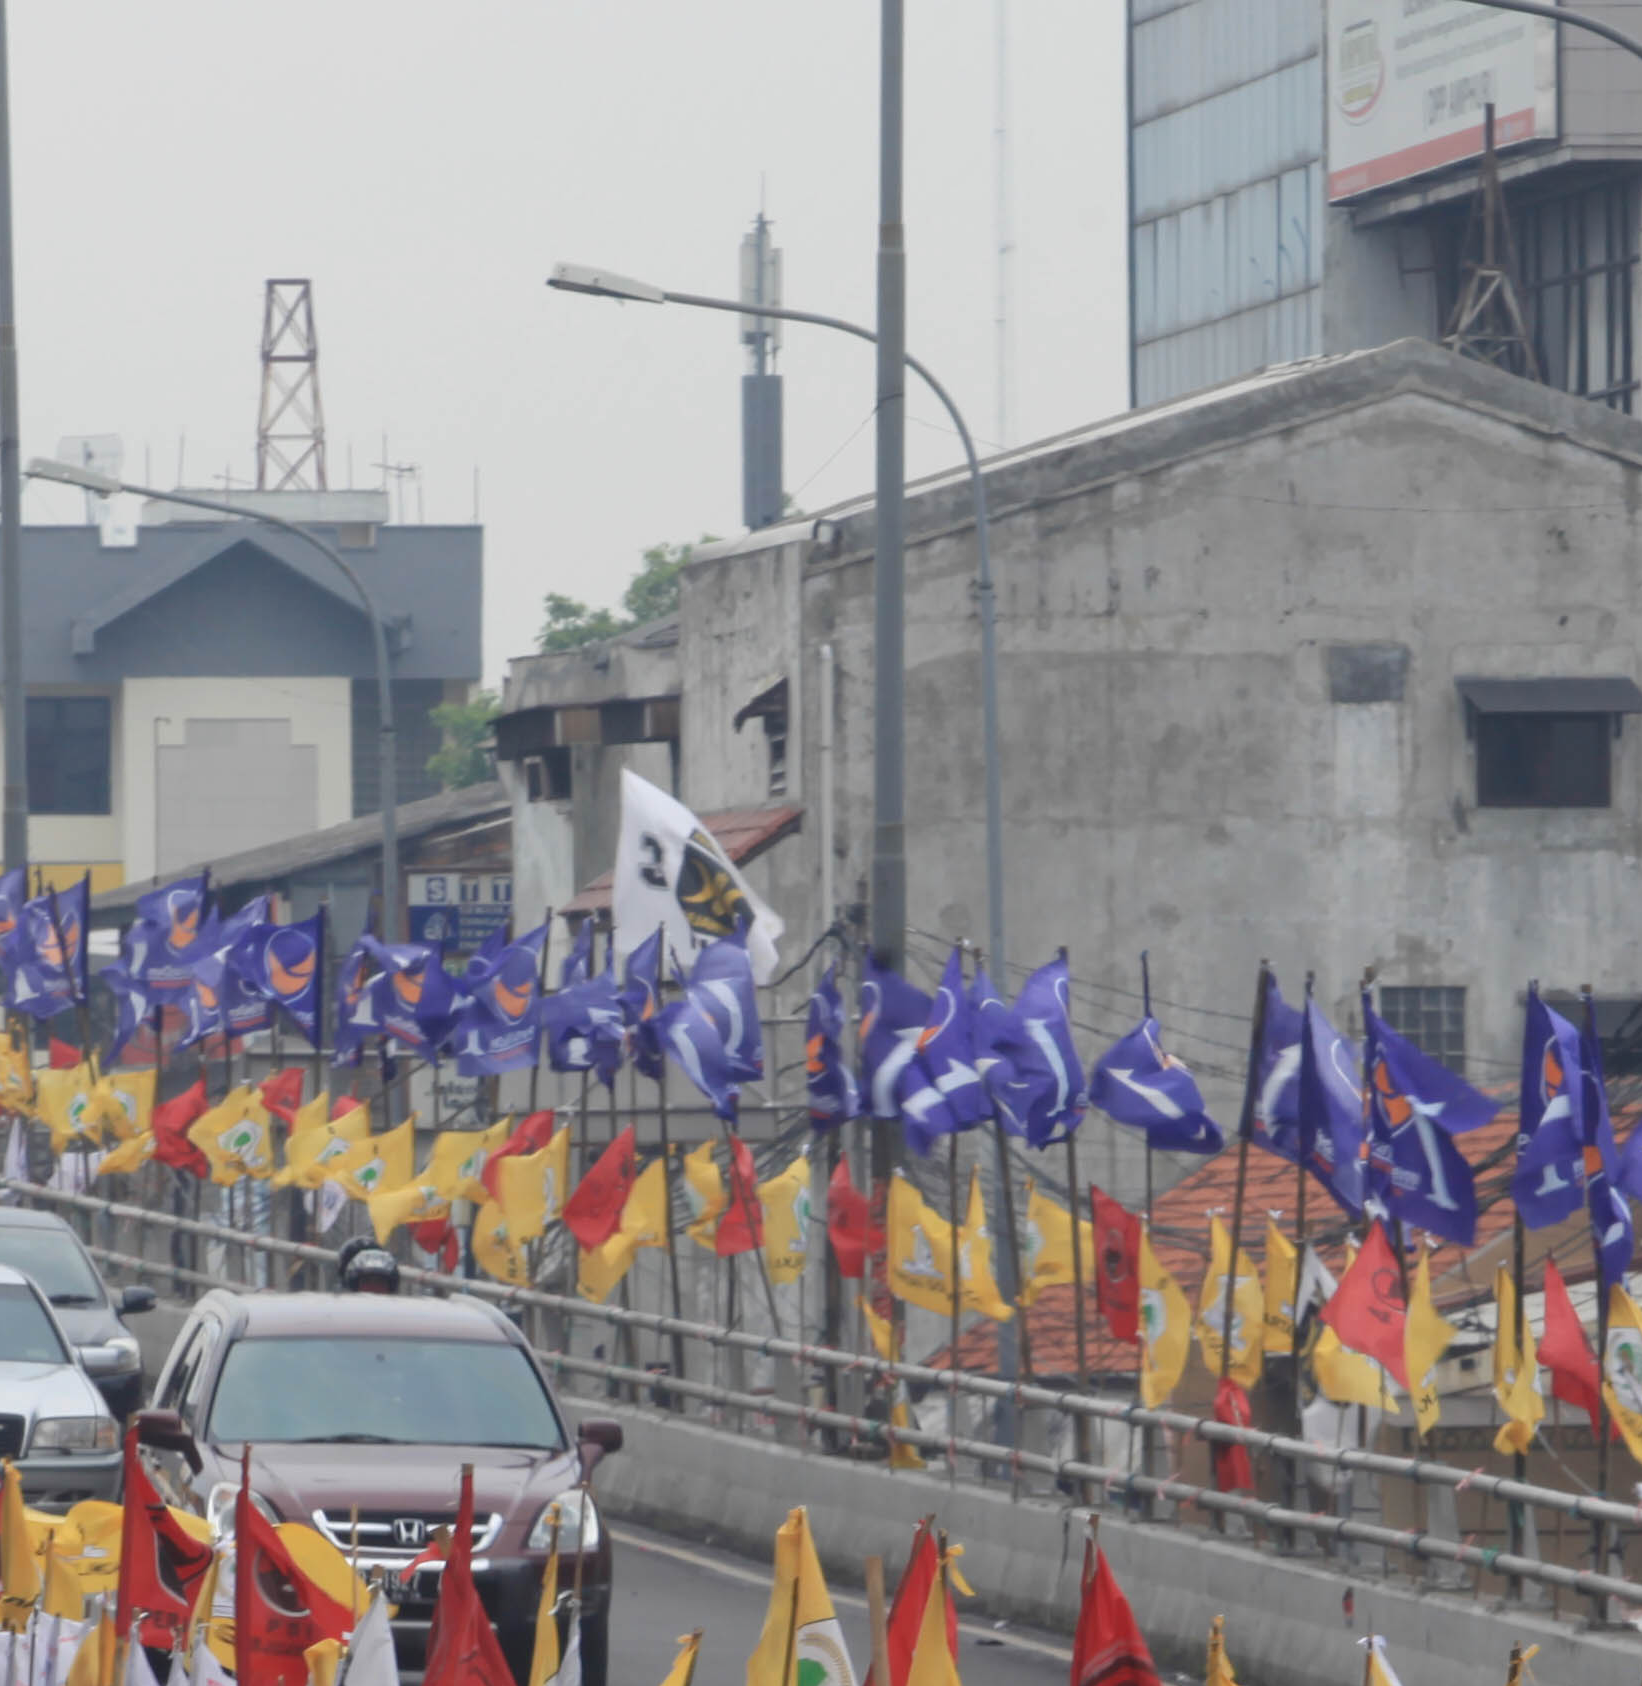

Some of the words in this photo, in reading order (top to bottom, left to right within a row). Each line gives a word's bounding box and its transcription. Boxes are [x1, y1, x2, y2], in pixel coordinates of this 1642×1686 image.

[637, 833, 668, 889] 3
[1024, 1018, 1069, 1117] 1
[1406, 1095, 1460, 1211] 1
